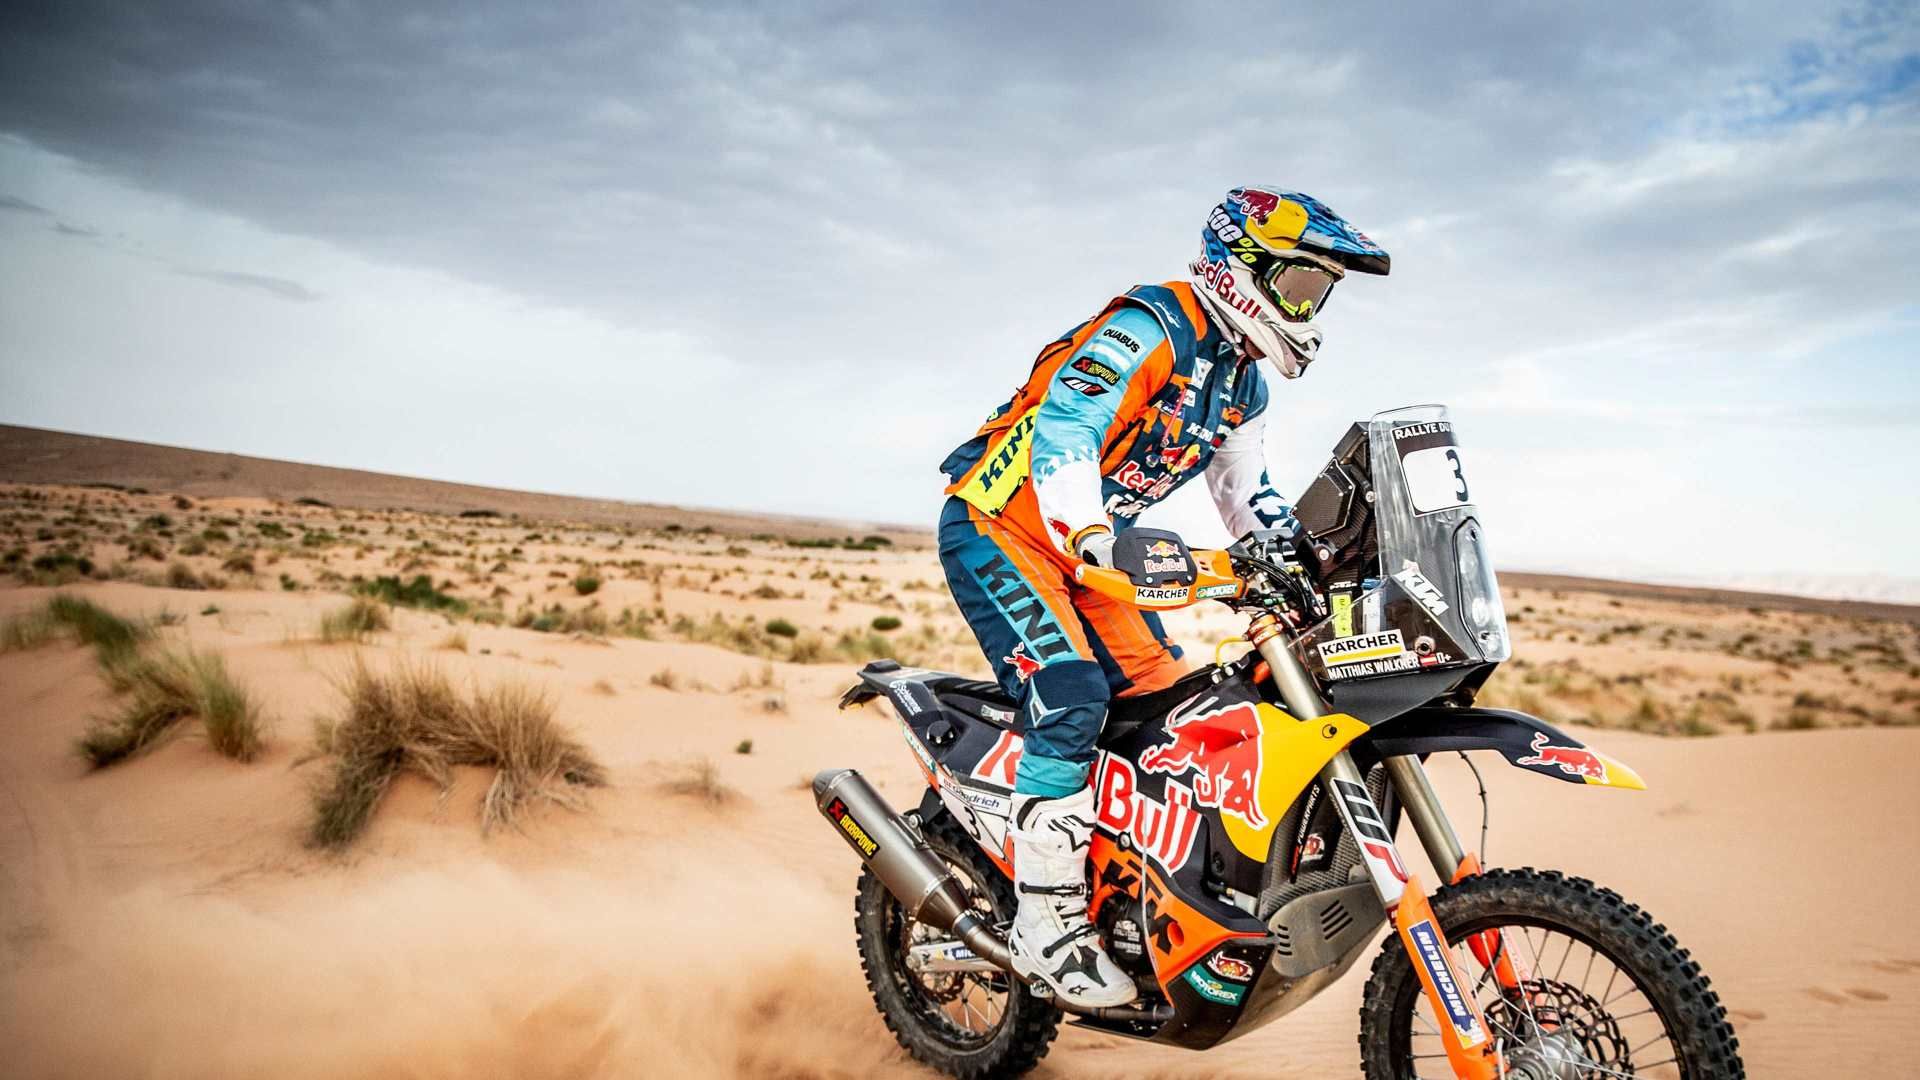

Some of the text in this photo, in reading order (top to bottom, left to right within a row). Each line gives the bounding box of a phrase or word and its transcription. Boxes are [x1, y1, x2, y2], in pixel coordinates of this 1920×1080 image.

[1216, 271, 1262, 319] Bull
[1394, 422, 1438, 440] RALLYE
[1445, 449, 1469, 502] 3
[974, 552, 1074, 662] KINI
[1321, 633, 1399, 656] KÄRCHER
[1328, 661, 1374, 681] MATTHIAS
[963, 806, 982, 841] 3
[1097, 755, 1200, 871] Bull
[1191, 970, 1239, 1000] MOTOREX
[1417, 931, 1467, 1017] MICHELIN
